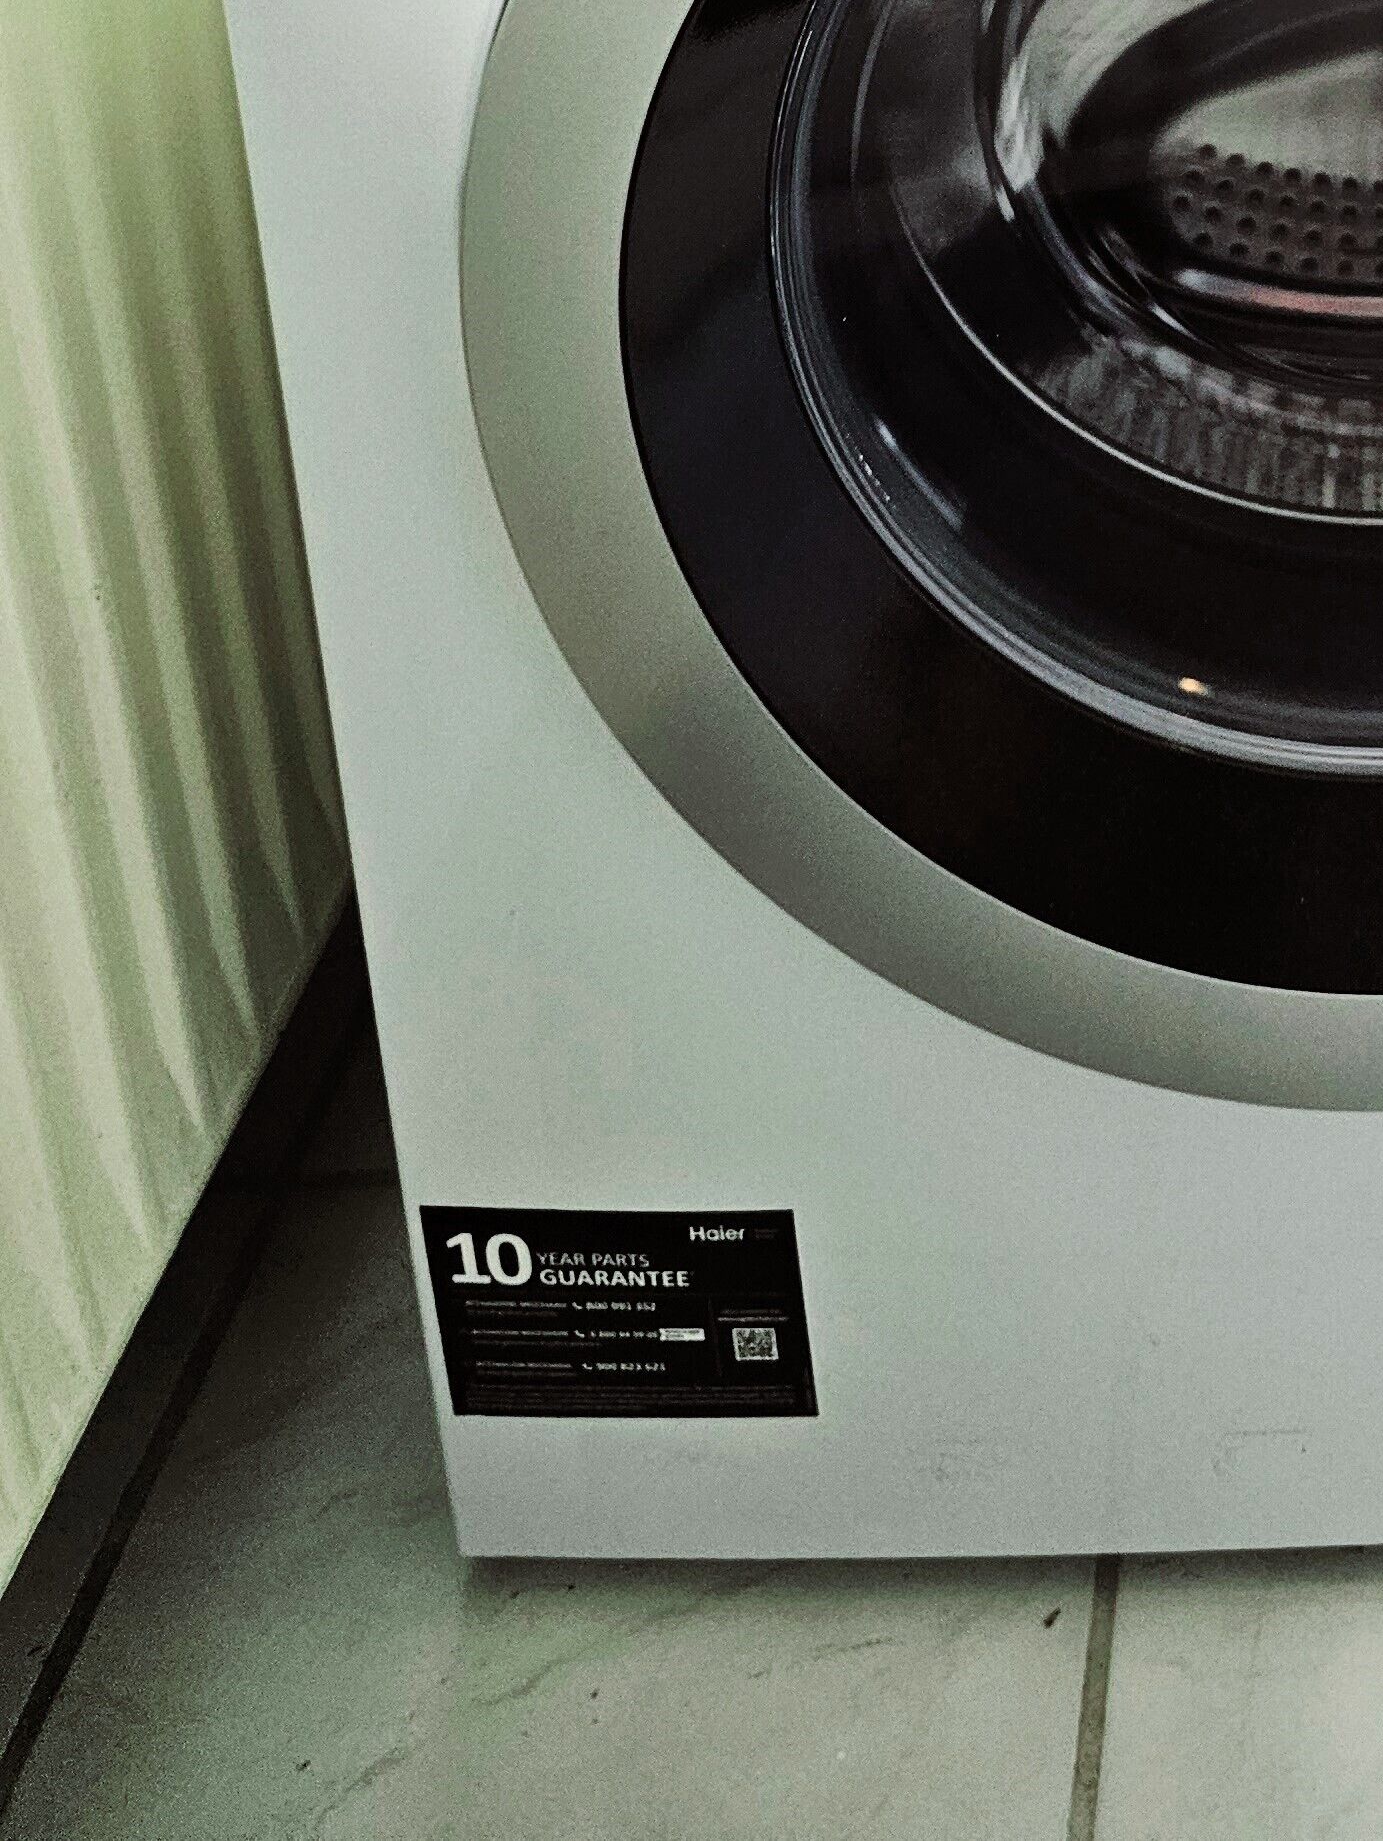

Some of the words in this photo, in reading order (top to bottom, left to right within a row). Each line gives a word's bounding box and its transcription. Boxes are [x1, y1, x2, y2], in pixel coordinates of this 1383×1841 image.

[689, 1224, 745, 1242] Haier
[445, 1232, 533, 1286] 10
[536, 1252, 586, 1266] YEAR
[591, 1252, 650, 1268] PARTS
